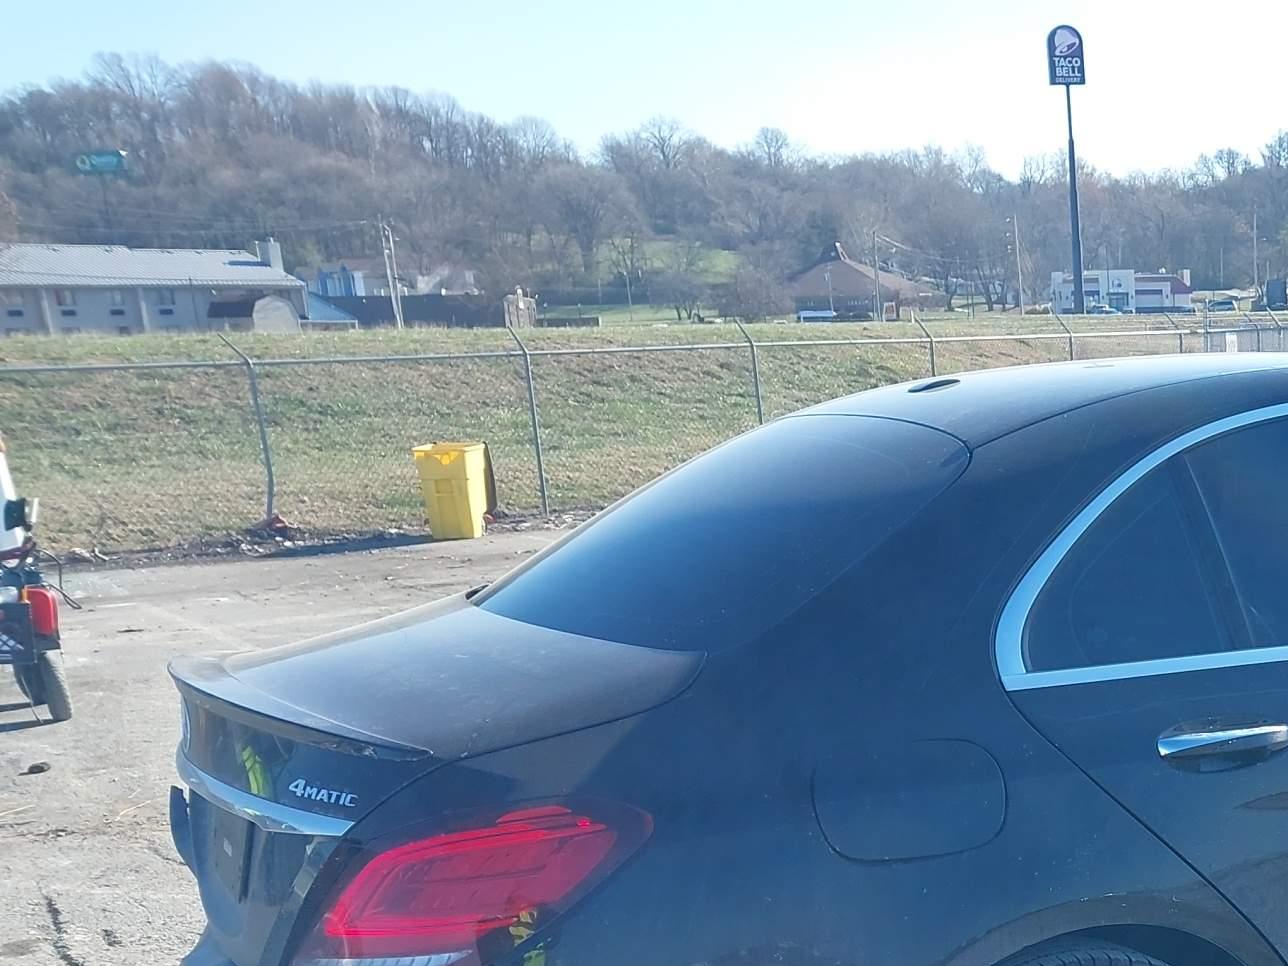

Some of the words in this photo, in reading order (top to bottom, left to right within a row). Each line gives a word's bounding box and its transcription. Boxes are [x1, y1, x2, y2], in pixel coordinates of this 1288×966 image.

[1053, 57, 1081, 67] TACO
[1056, 67, 1081, 76] BELL
[289, 779, 359, 807] 4MATIC
